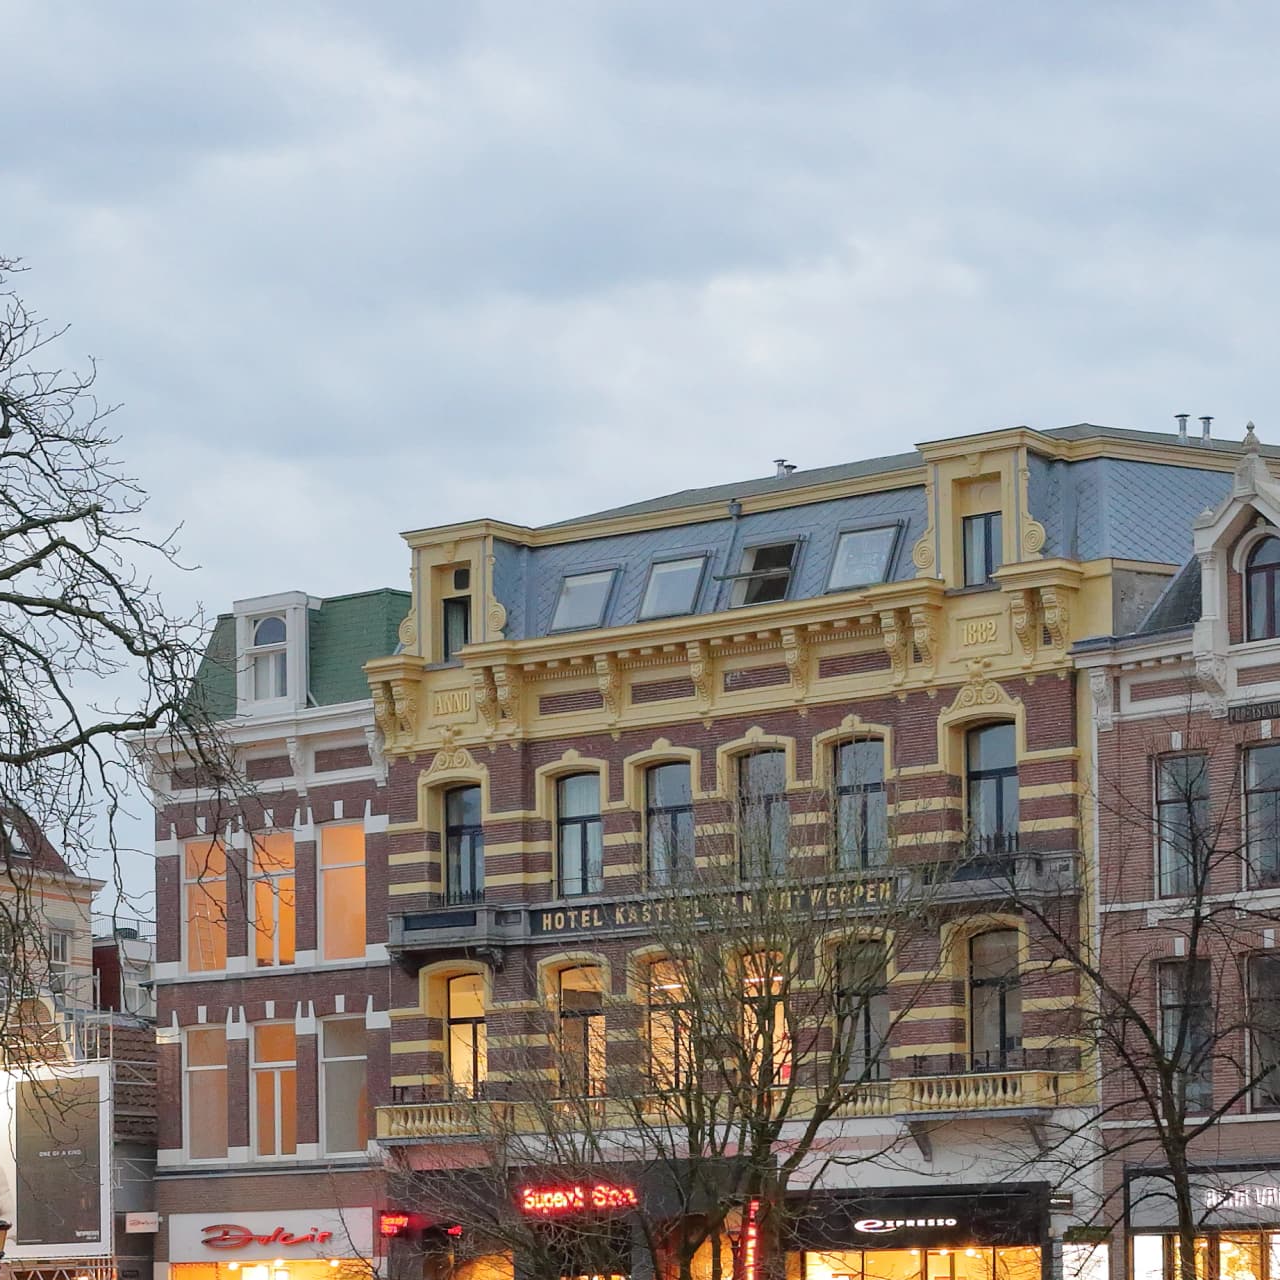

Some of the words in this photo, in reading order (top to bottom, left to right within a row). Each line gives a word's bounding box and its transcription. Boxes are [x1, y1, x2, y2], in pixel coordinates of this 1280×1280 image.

[963, 619, 997, 646] 1882
[433, 690, 471, 716] ANNO
[542, 909, 603, 931] HOTEL
